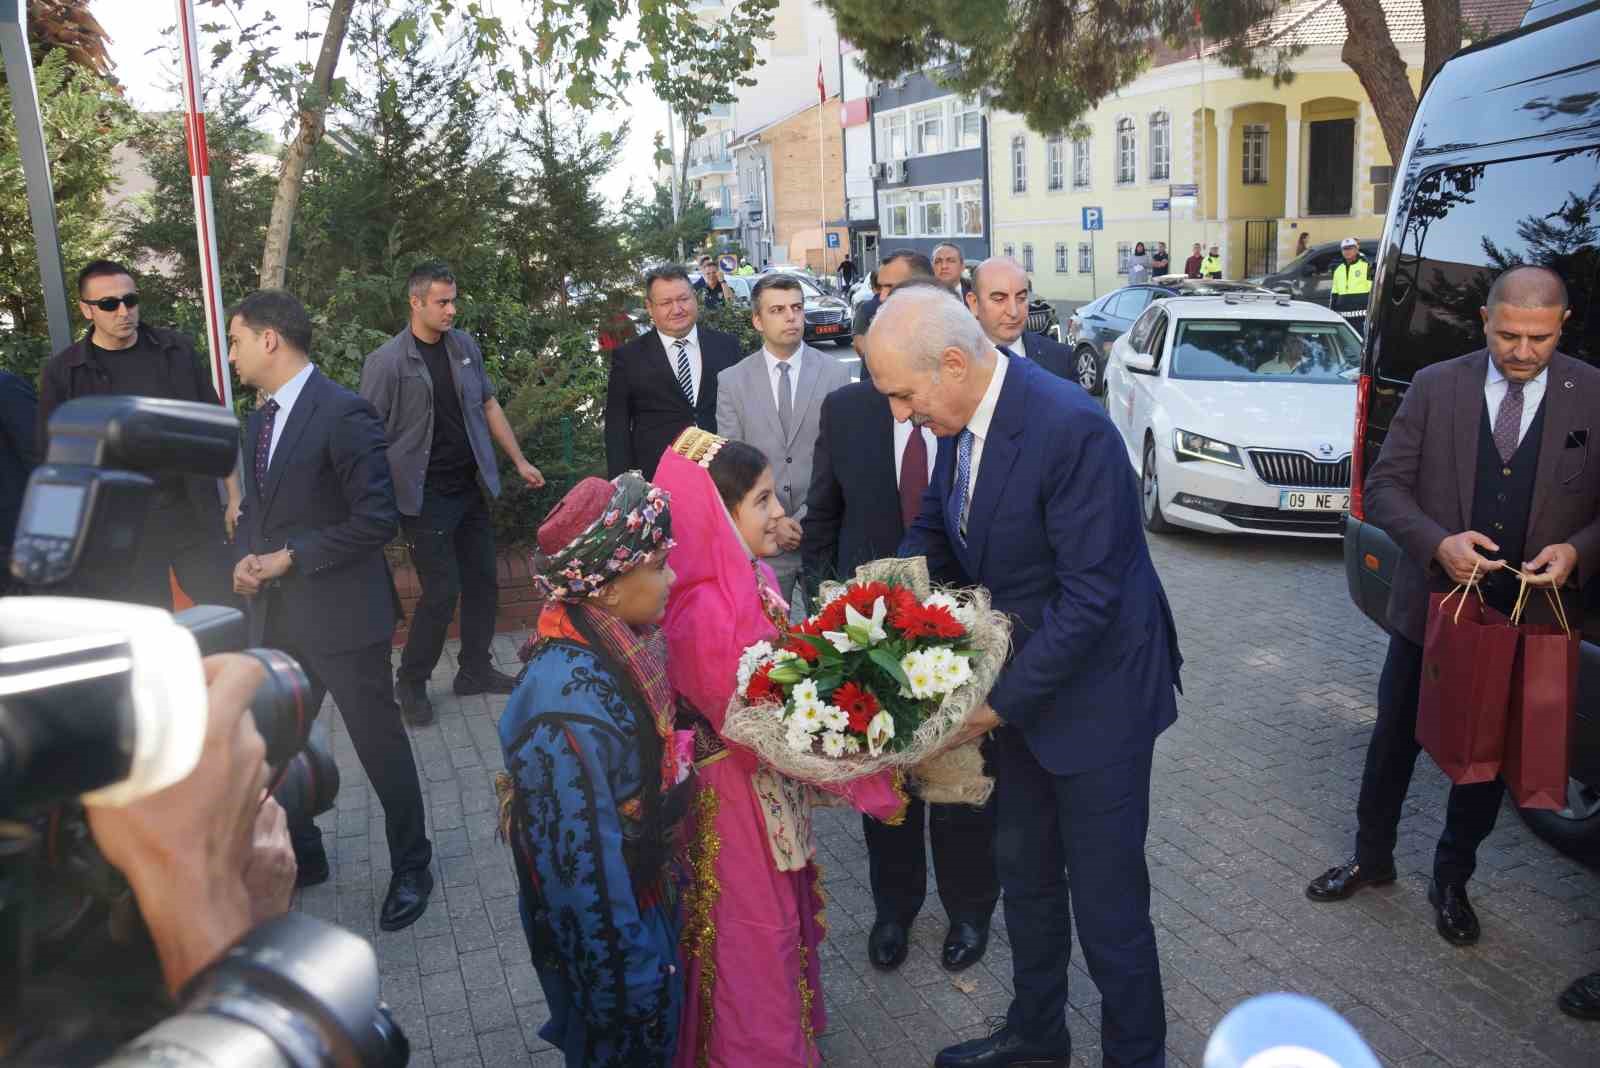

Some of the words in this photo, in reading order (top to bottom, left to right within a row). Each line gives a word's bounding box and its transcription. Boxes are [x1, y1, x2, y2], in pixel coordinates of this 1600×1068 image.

[1087, 209, 1098, 228] P
[828, 234, 837, 246] P
[1289, 493, 1305, 508] 09
[1315, 494, 1333, 509] NE
